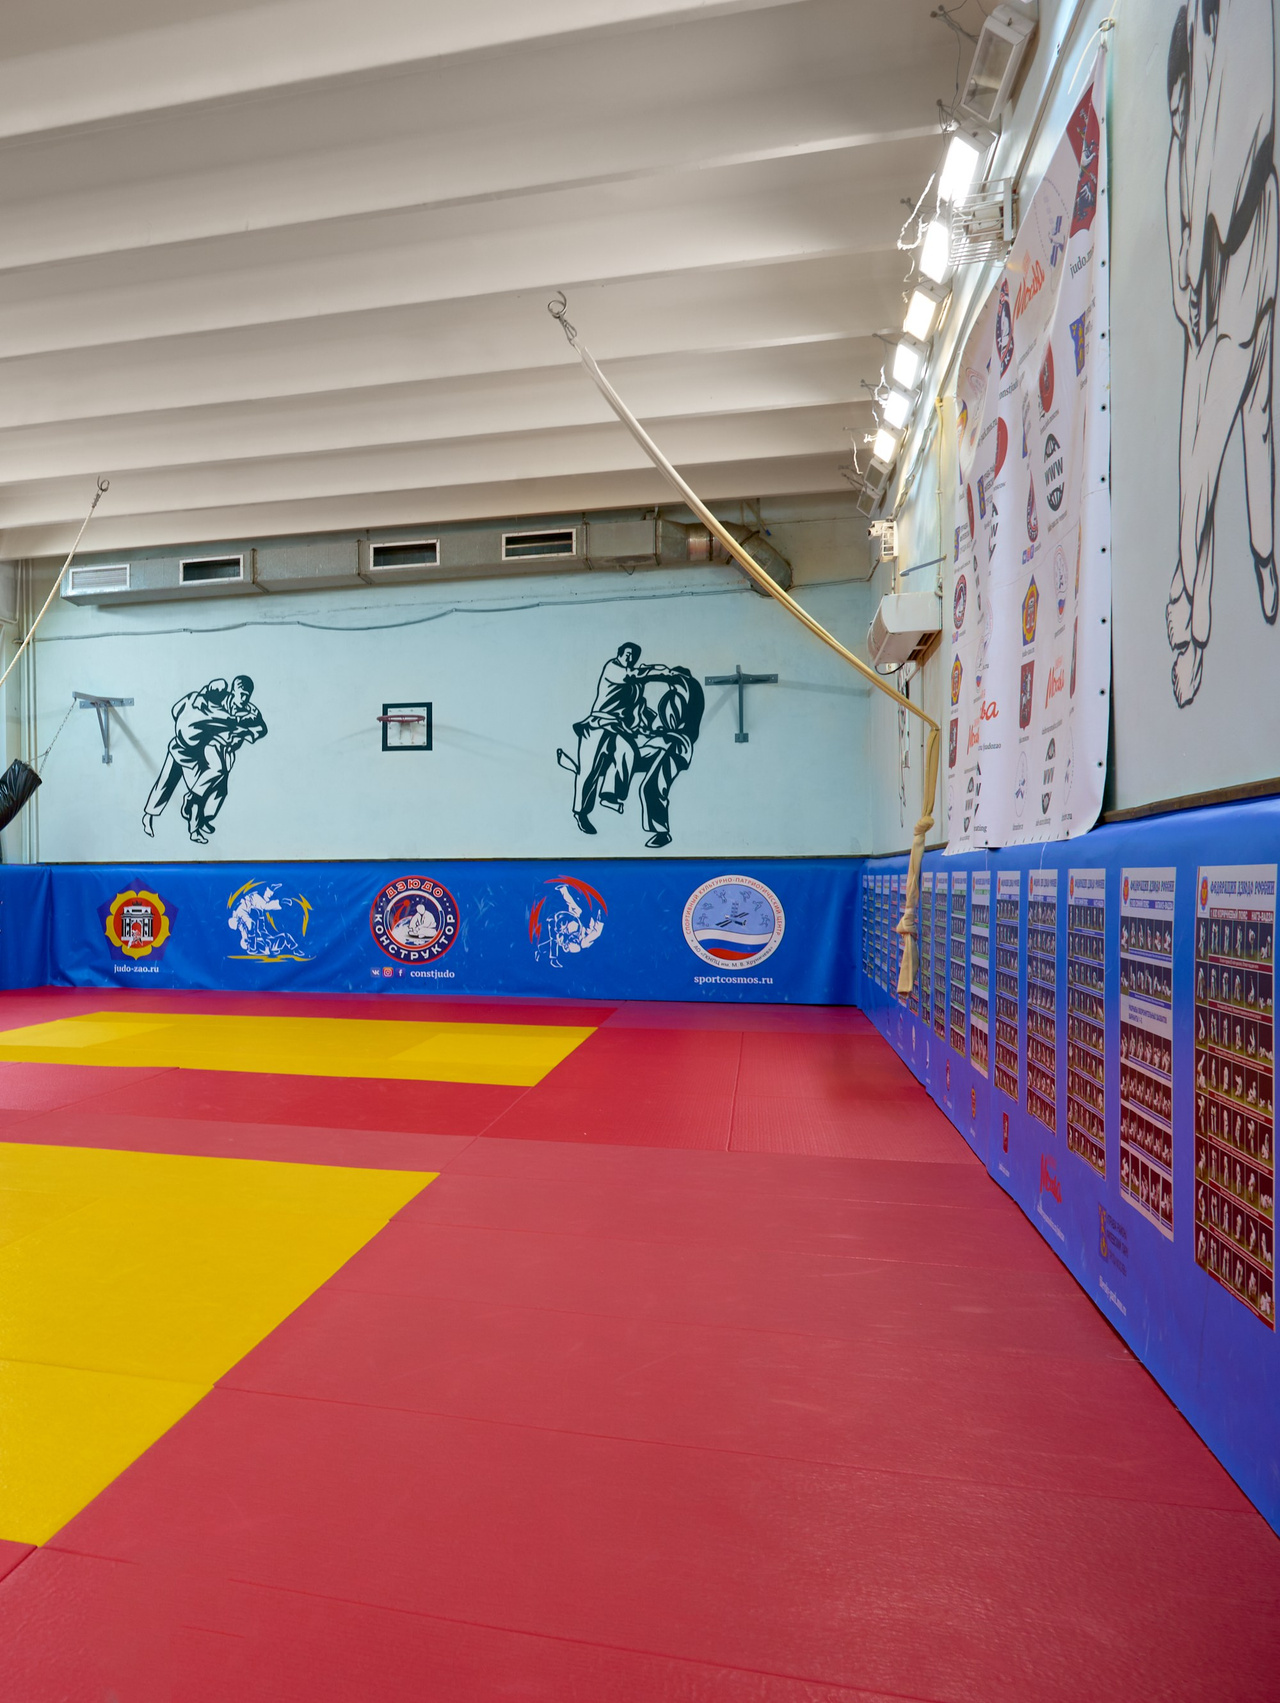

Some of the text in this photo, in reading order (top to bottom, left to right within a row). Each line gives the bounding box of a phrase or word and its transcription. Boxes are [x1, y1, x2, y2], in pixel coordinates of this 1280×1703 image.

[386, 879, 443, 899] ДЗЮДО
[684, 894, 699, 935] СПОРТИВНЫЙ
[374, 914, 455, 960] КОНСТРУКТОР
[114, 964, 160, 974] judo-zao.ru
[410, 969, 456, 979] constjudo
[694, 976, 774, 985] sportcosmos.ru
